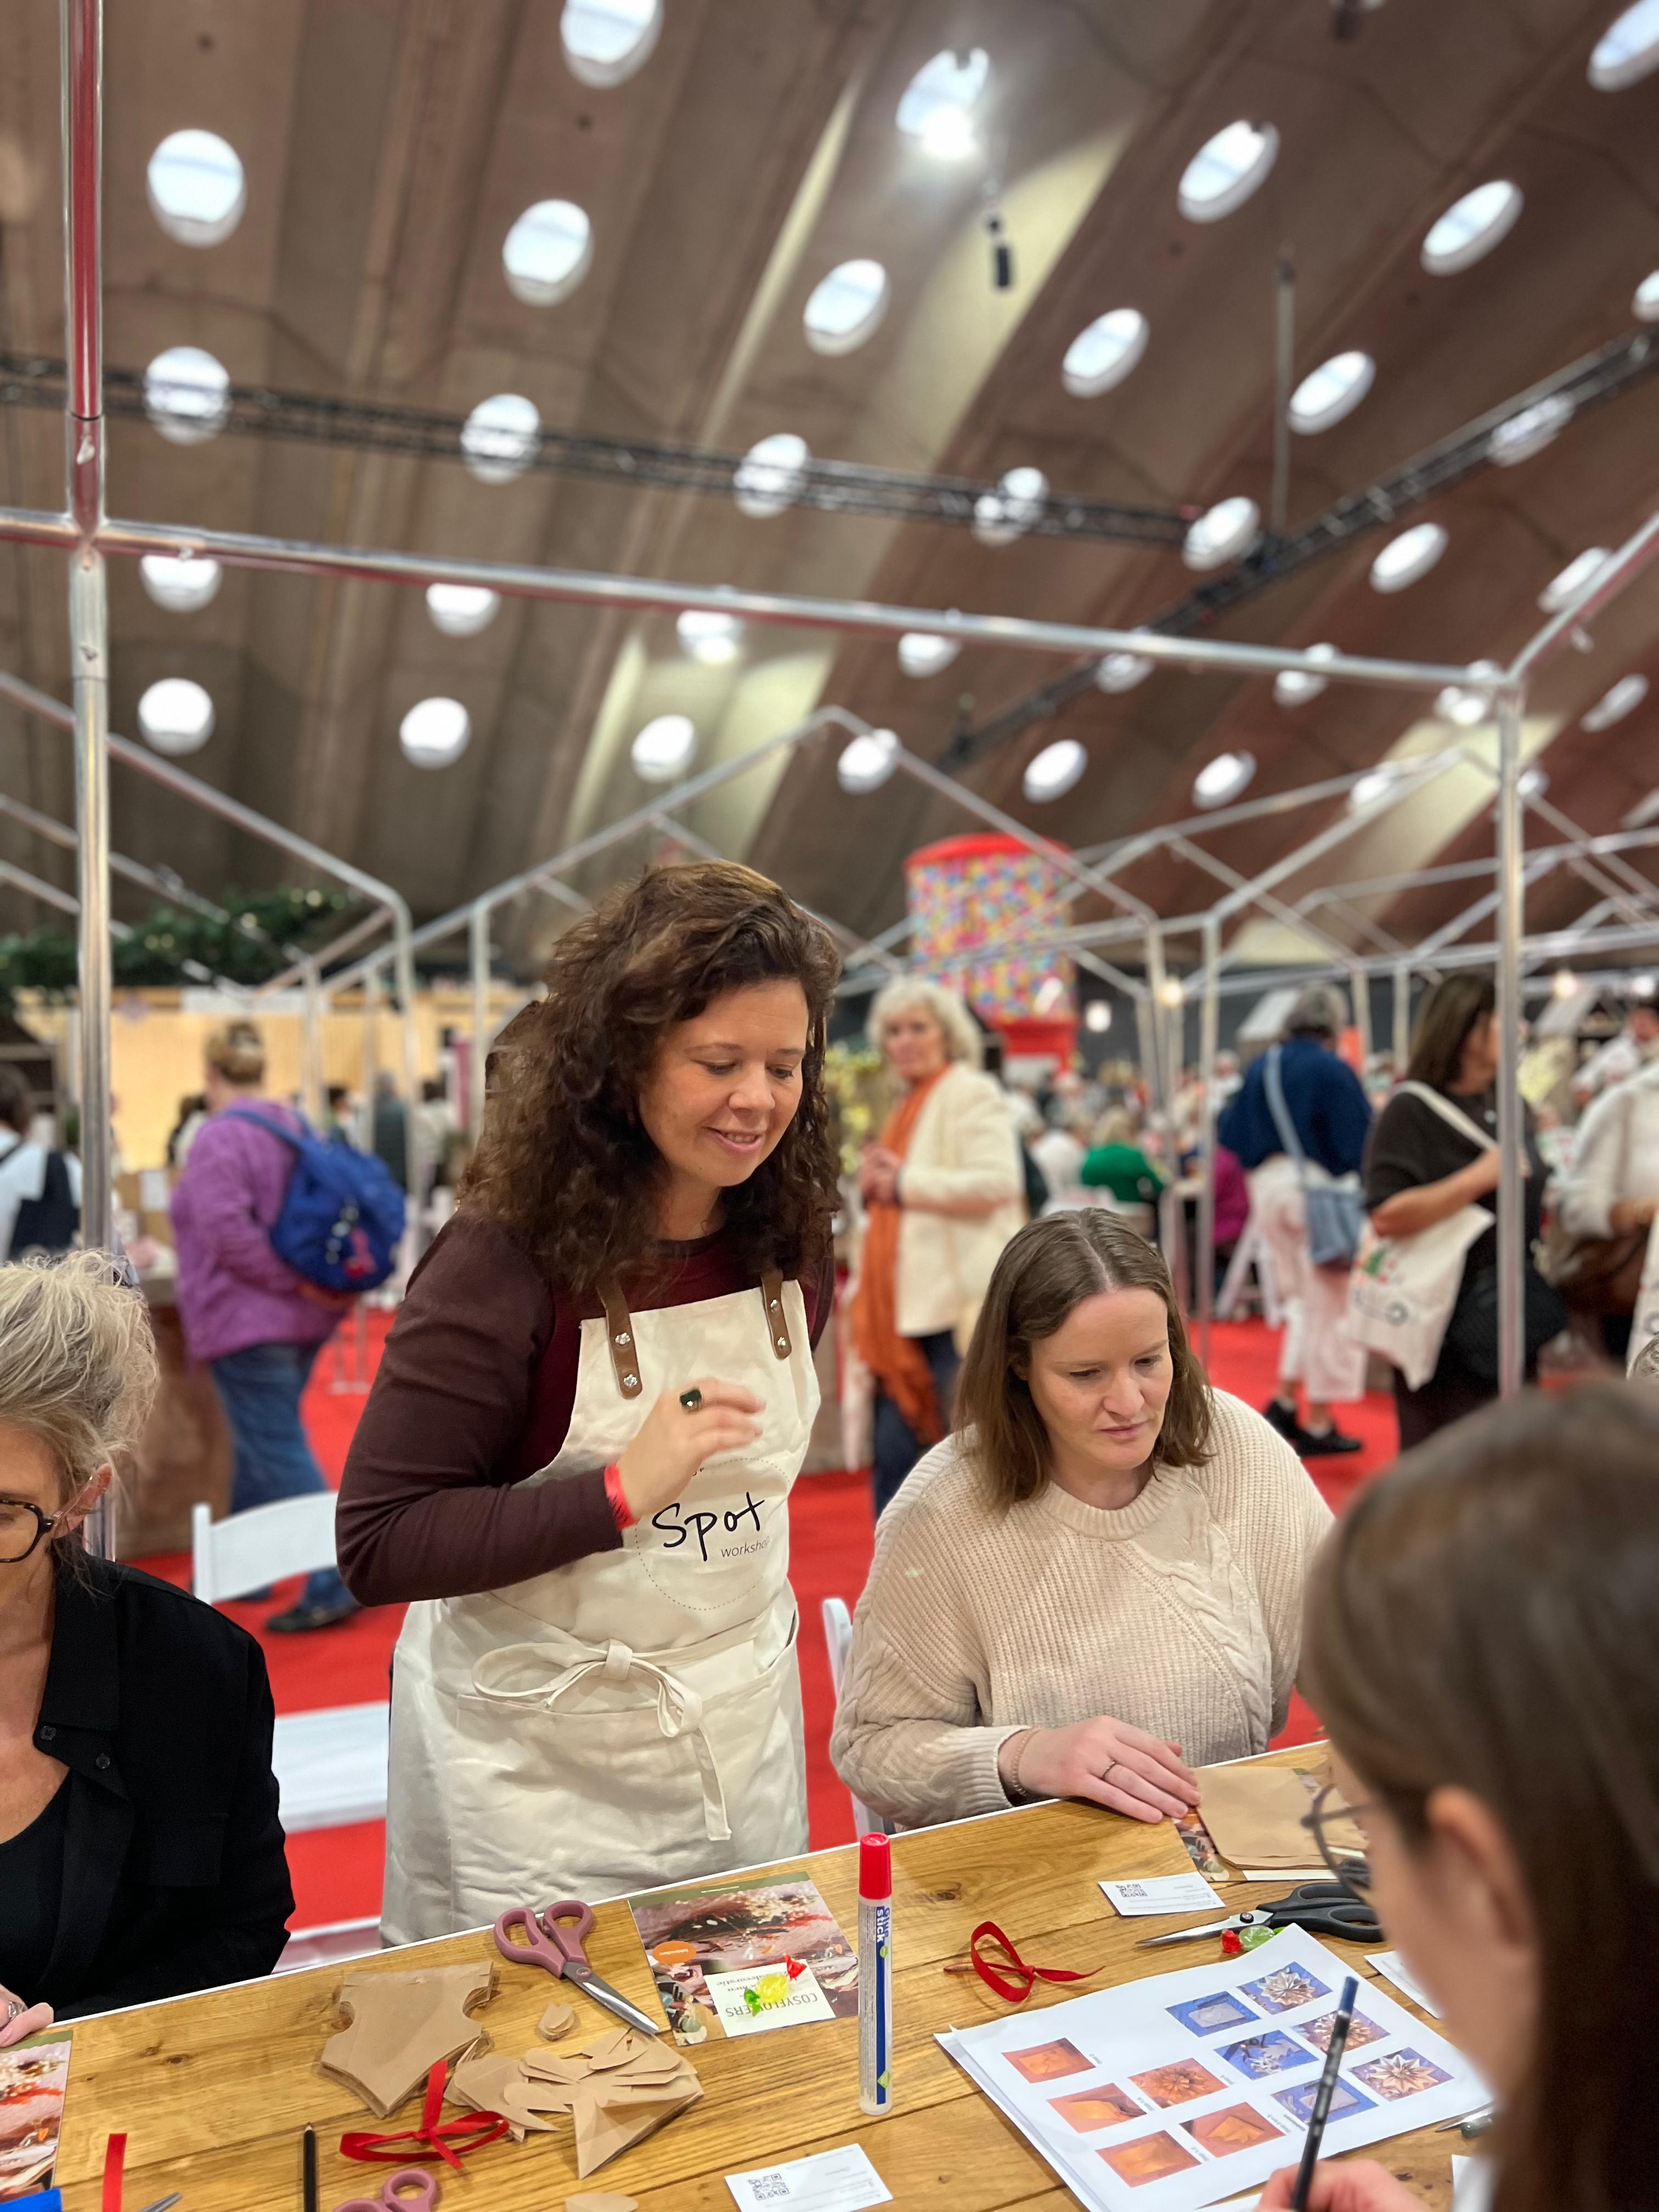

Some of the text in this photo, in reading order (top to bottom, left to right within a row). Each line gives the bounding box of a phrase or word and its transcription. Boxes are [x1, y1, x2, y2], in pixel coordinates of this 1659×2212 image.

[652, 1492, 765, 1561] Spot
[877, 1909, 885, 1942] stick
[725, 1993, 818, 2017] COSYFLOERS
